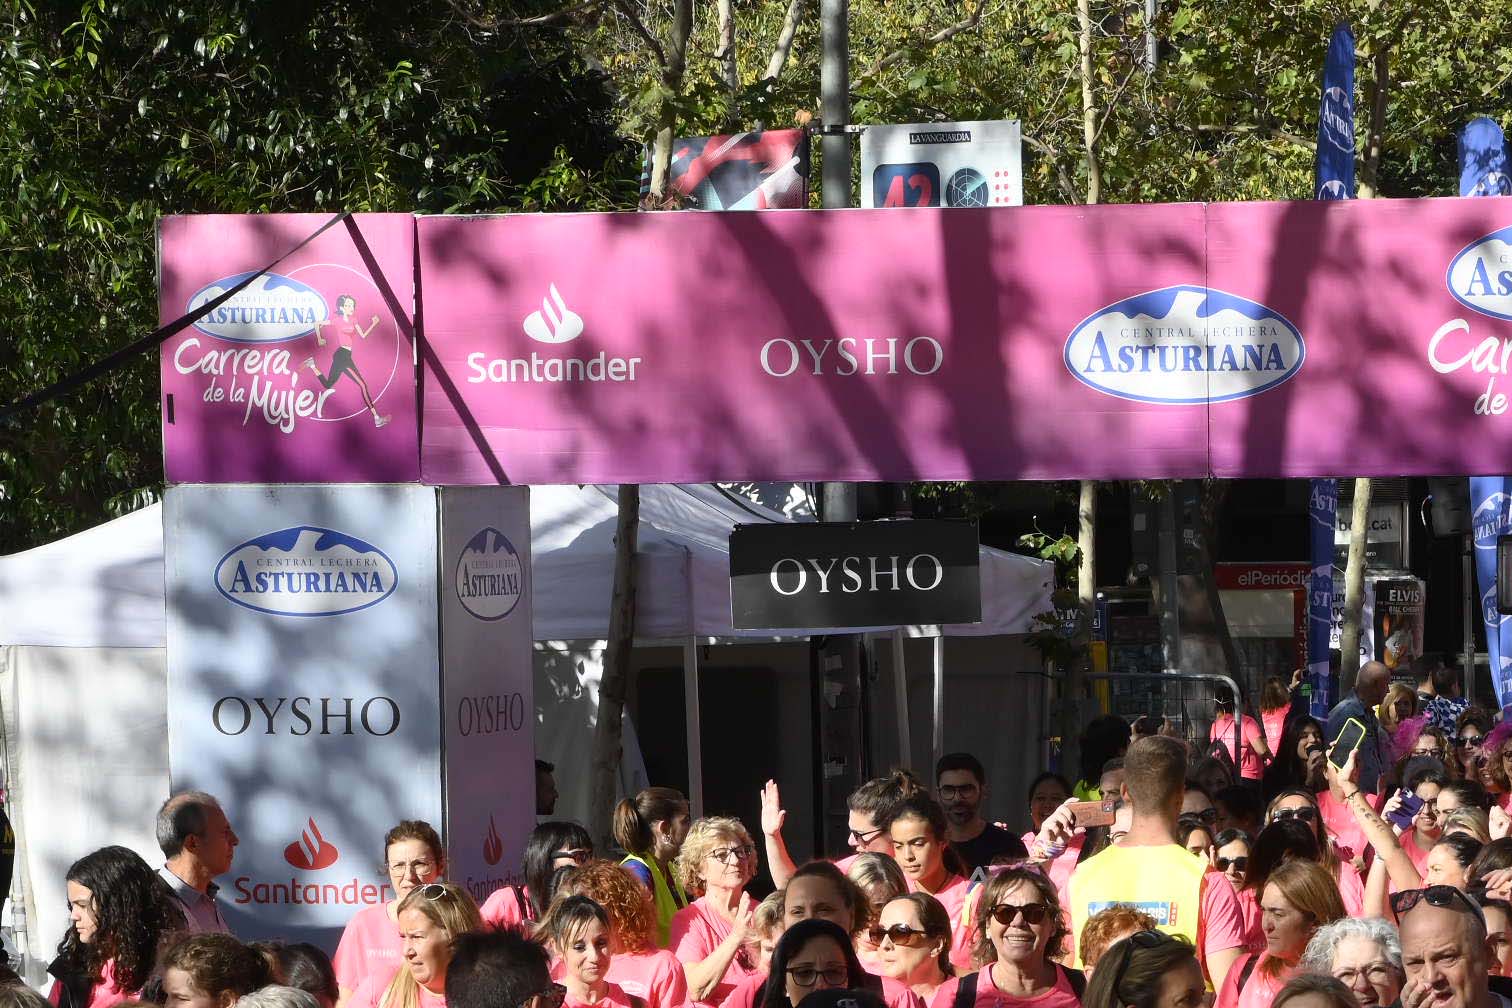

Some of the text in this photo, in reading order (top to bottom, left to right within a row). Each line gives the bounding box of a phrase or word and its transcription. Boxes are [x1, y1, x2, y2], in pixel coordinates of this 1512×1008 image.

[198, 297, 317, 325] ASTURIANA
[1120, 325, 1279, 337] CENTRAL LECHERA
[174, 338, 291, 375] Carrera
[467, 351, 641, 383] Santander
[760, 335, 944, 376] OYSHO
[1083, 331, 1287, 374] ASTURIANA
[203, 371, 336, 433] de la Mujer
[1473, 376, 1507, 416] de
[228, 560, 385, 594] ASTURIANA
[256, 558, 379, 567] CENTRAL LECHERA
[769, 553, 943, 595] OYSHO
[461, 567, 519, 599] ASTURIANA
[1389, 590, 1420, 602] ELVIS
[212, 696, 401, 737] OYSHO
[458, 692, 525, 737] OYSHO
[234, 877, 391, 905] Santander
